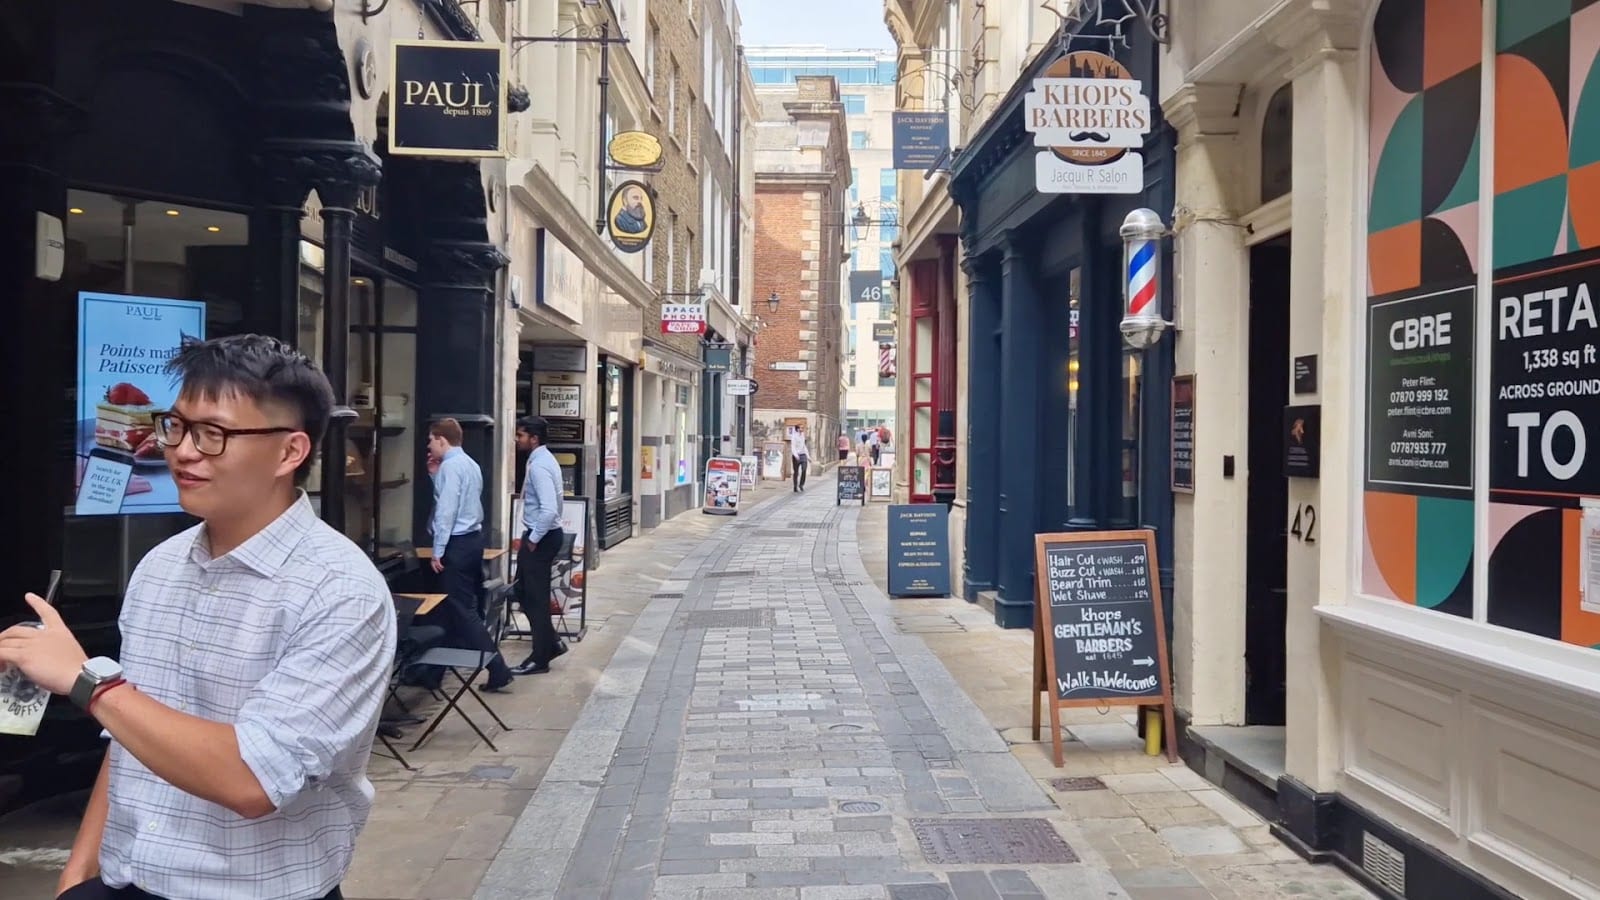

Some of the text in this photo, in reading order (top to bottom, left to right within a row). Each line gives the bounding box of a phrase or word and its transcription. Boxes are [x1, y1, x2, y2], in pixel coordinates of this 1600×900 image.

[403, 80, 492, 108] PAUL
[1044, 84, 1132, 106] KHOPS
[443, 108, 492, 119] depuis 1889
[1032, 108, 1145, 129] BARBERS
[1072, 149, 1107, 158] SINCE 1845
[1051, 168, 1127, 184] Jacqui R Salon
[861, 286, 881, 301] 46
[127, 305, 162, 317] PAUL
[1499, 282, 1598, 341] RETA
[1389, 312, 1452, 351] CBRE
[100, 344, 146, 358] Points
[1523, 344, 1596, 373] 1,338 sq ft
[1402, 378, 1418, 388] Peter
[1499, 379, 1600, 400] ACROSS GROUND
[1390, 389, 1449, 403] 07870 999 192
[1390, 442, 1447, 455] 07787933 777
[1508, 410, 1586, 480] TO
[1291, 503, 1316, 543] 42
[1049, 555, 1073, 567] Hair
[1076, 554, 1095, 565] Cut
[1050, 567, 1076, 579] Buzz
[1078, 566, 1096, 577] Cut
[1051, 579, 1083, 591] Beard
[1085, 577, 1112, 588] Trim
[1052, 591, 1073, 602] Wet
[1076, 589, 1107, 601] Shave
[1081, 608, 1122, 624] khops
[1054, 618, 1143, 639] GENTLEMAN'S
[1075, 638, 1133, 653] BARBERS
[1057, 671, 1090, 692] Walk
[8, 698, 43, 717] COFFEE
